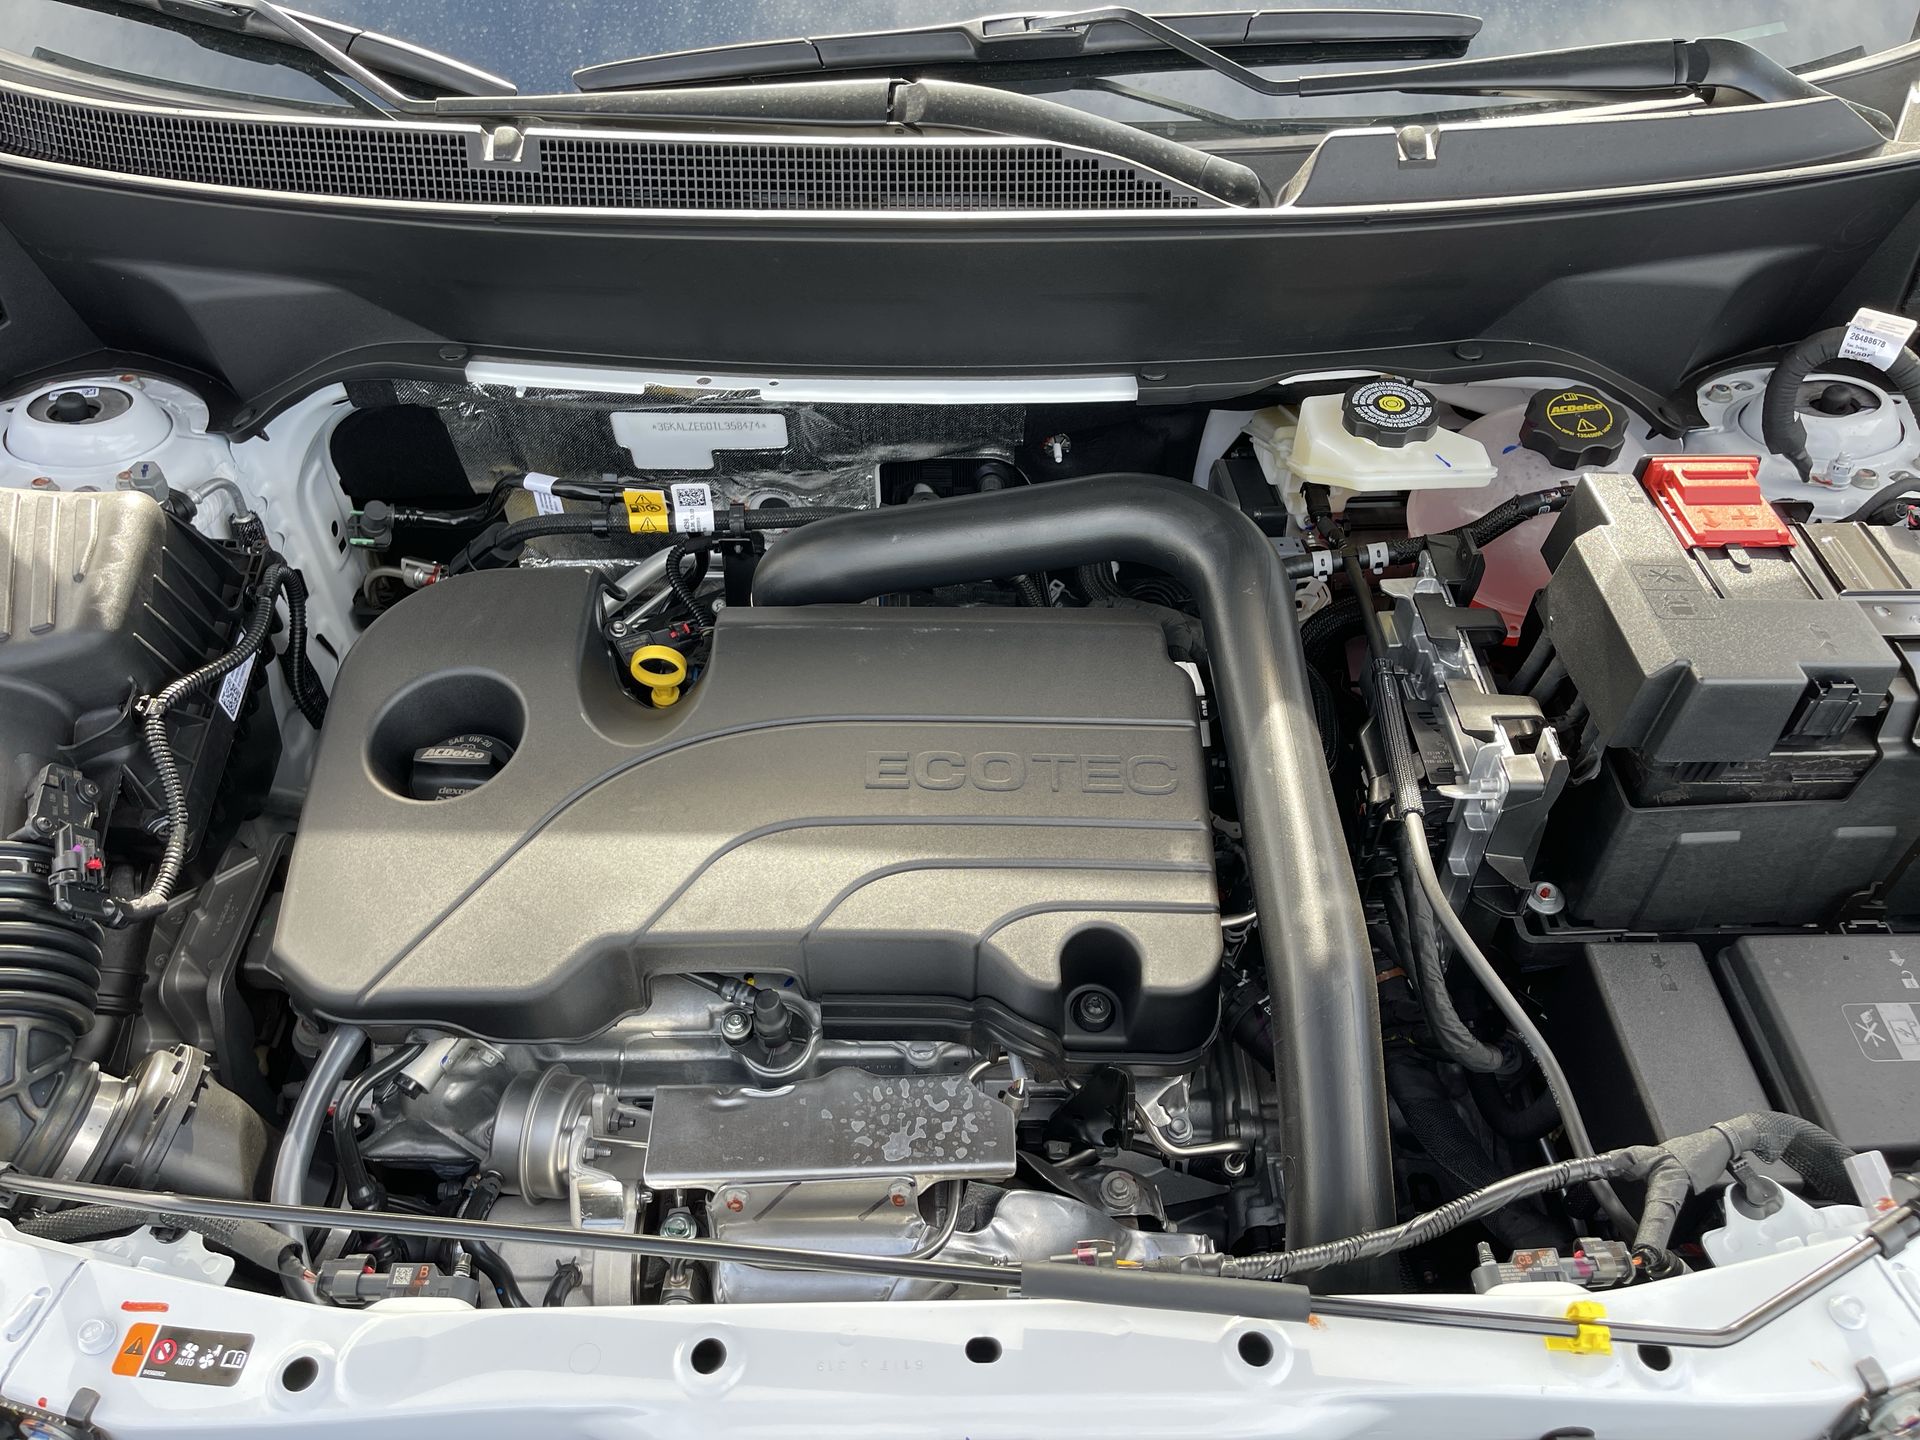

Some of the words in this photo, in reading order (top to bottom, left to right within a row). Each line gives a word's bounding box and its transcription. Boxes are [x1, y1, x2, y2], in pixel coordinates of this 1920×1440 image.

[1849, 332, 1887, 348] 26488678
[1550, 403, 1603, 414] ACDelco
[448, 736, 465, 746] SAE
[468, 735, 493, 748] 0W-20
[420, 748, 485, 760] ACDelco
[863, 750, 1179, 795] ECOTEC
[420, 1265, 429, 1277] B
[175, 1357, 195, 1367] AUTO
